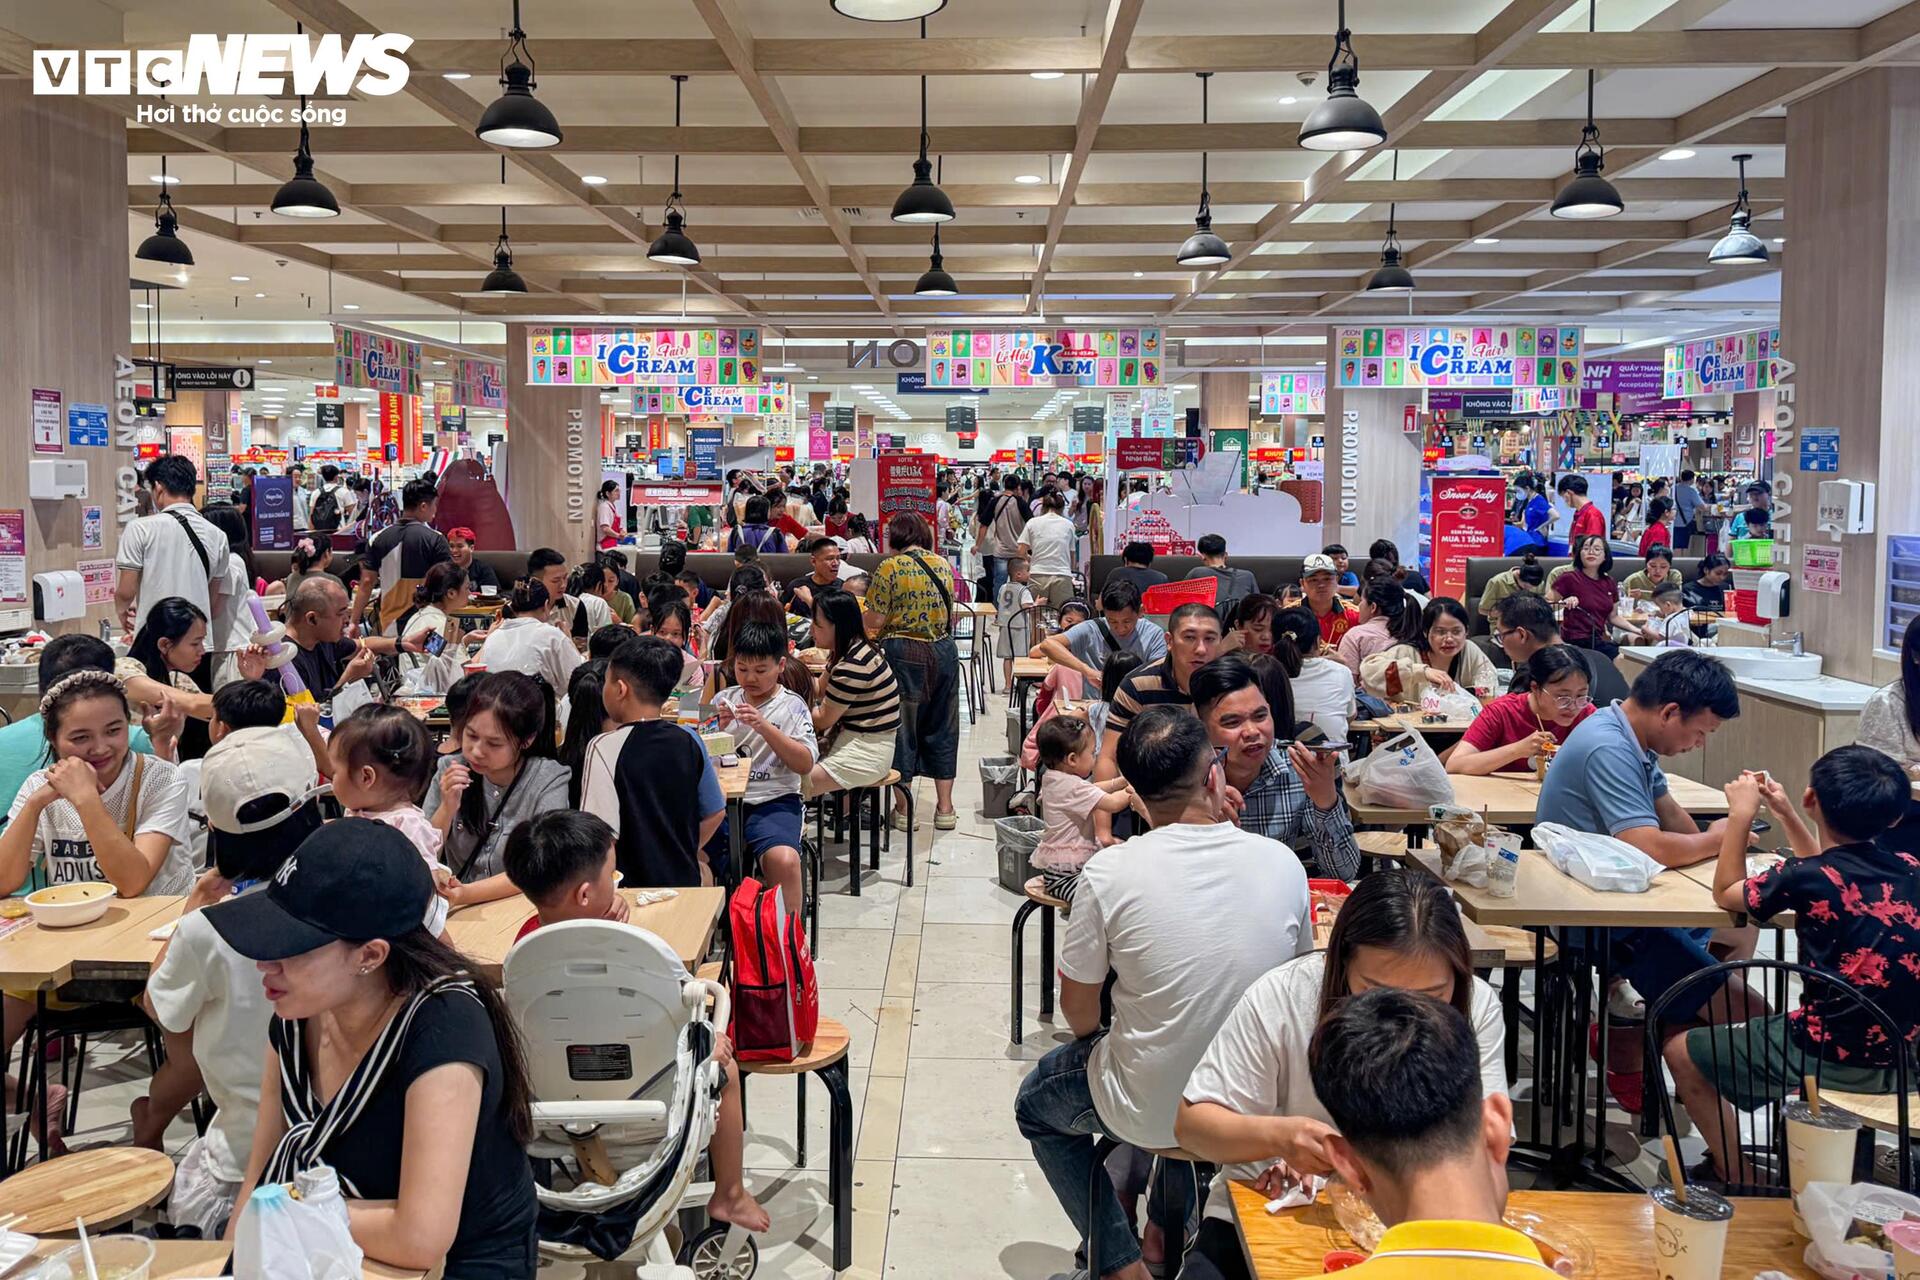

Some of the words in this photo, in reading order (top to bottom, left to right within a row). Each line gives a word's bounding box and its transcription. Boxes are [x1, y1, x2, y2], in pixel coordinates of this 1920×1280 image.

[656, 344, 688, 358] Fair
[1030, 344, 1093, 374] KEM
[1472, 344, 1506, 358] Fair
[115, 354, 137, 447] AEON
[1465, 399, 1491, 408] KHÔNG
[1774, 357, 1796, 452] AEON
[567, 408, 583, 522] PROMOTION
[1340, 410, 1359, 525] PROMOTION
[1439, 488, 1470, 500] Snow
[1470, 488, 1498, 503] Baby
[1771, 471, 1793, 564] CAFE
[1467, 535, 1489, 545] TẶNG
